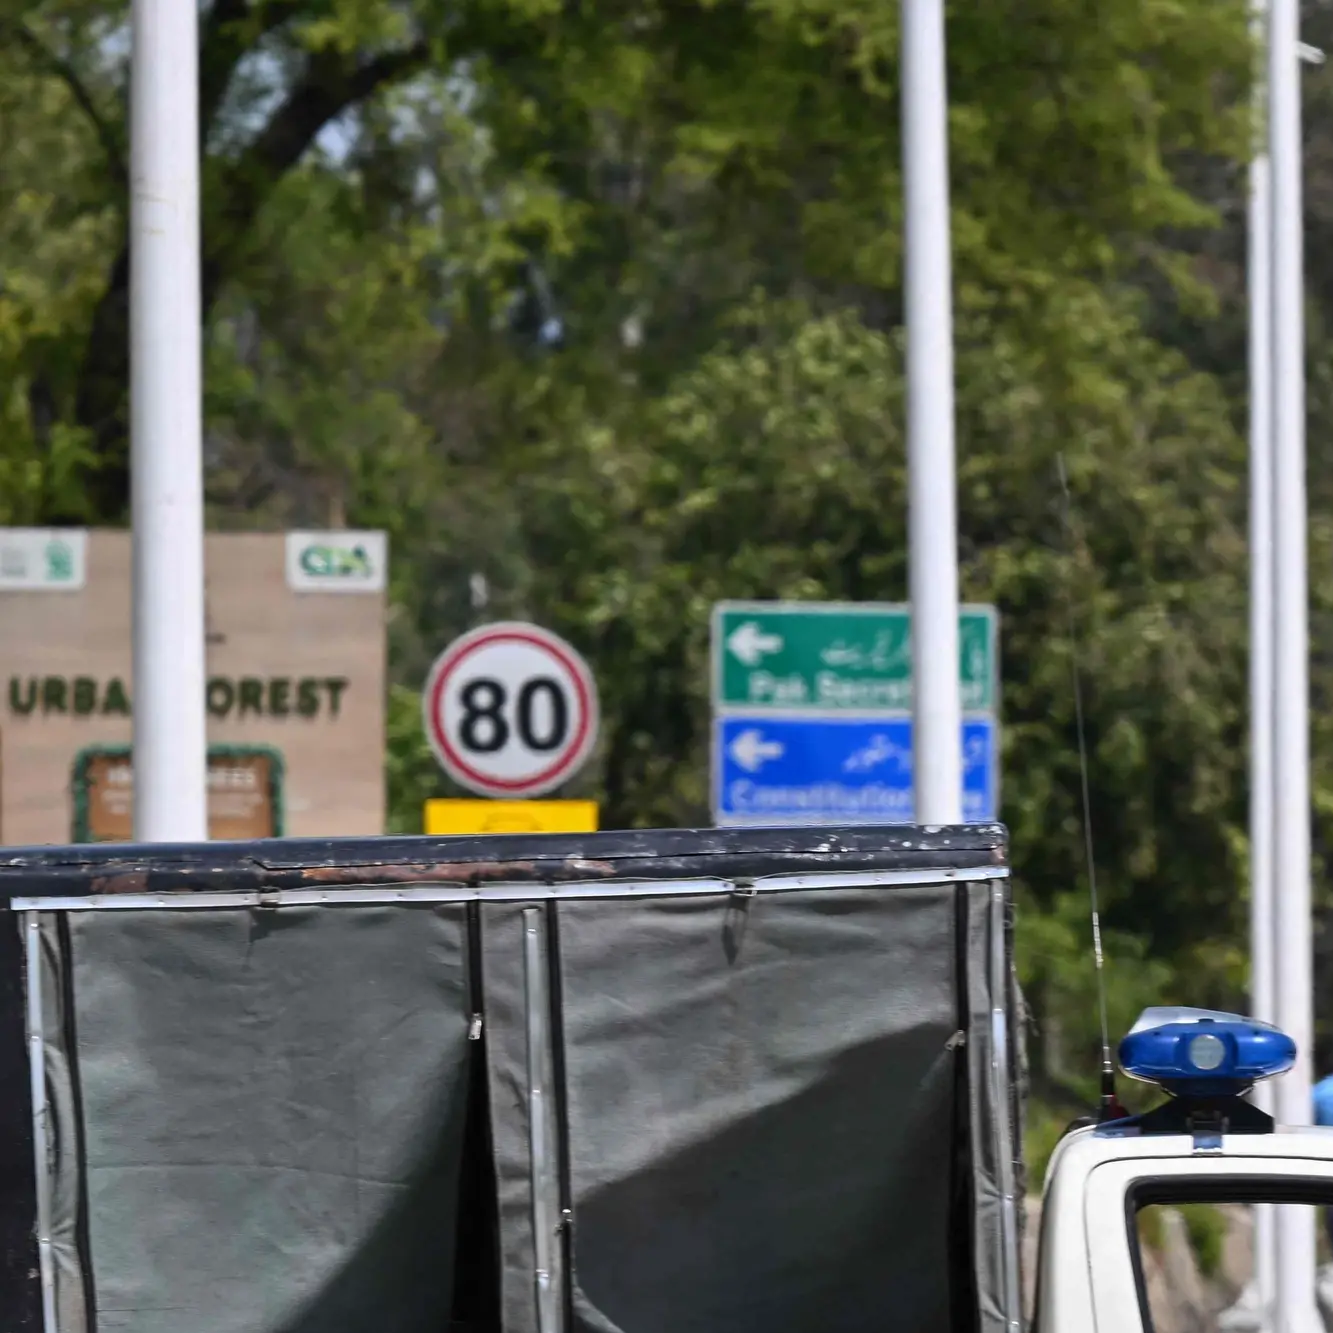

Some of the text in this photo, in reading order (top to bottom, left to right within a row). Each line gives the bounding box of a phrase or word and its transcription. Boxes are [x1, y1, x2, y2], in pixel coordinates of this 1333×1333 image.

[8, 676, 350, 718] URBA OREST
[459, 677, 567, 754] 80
